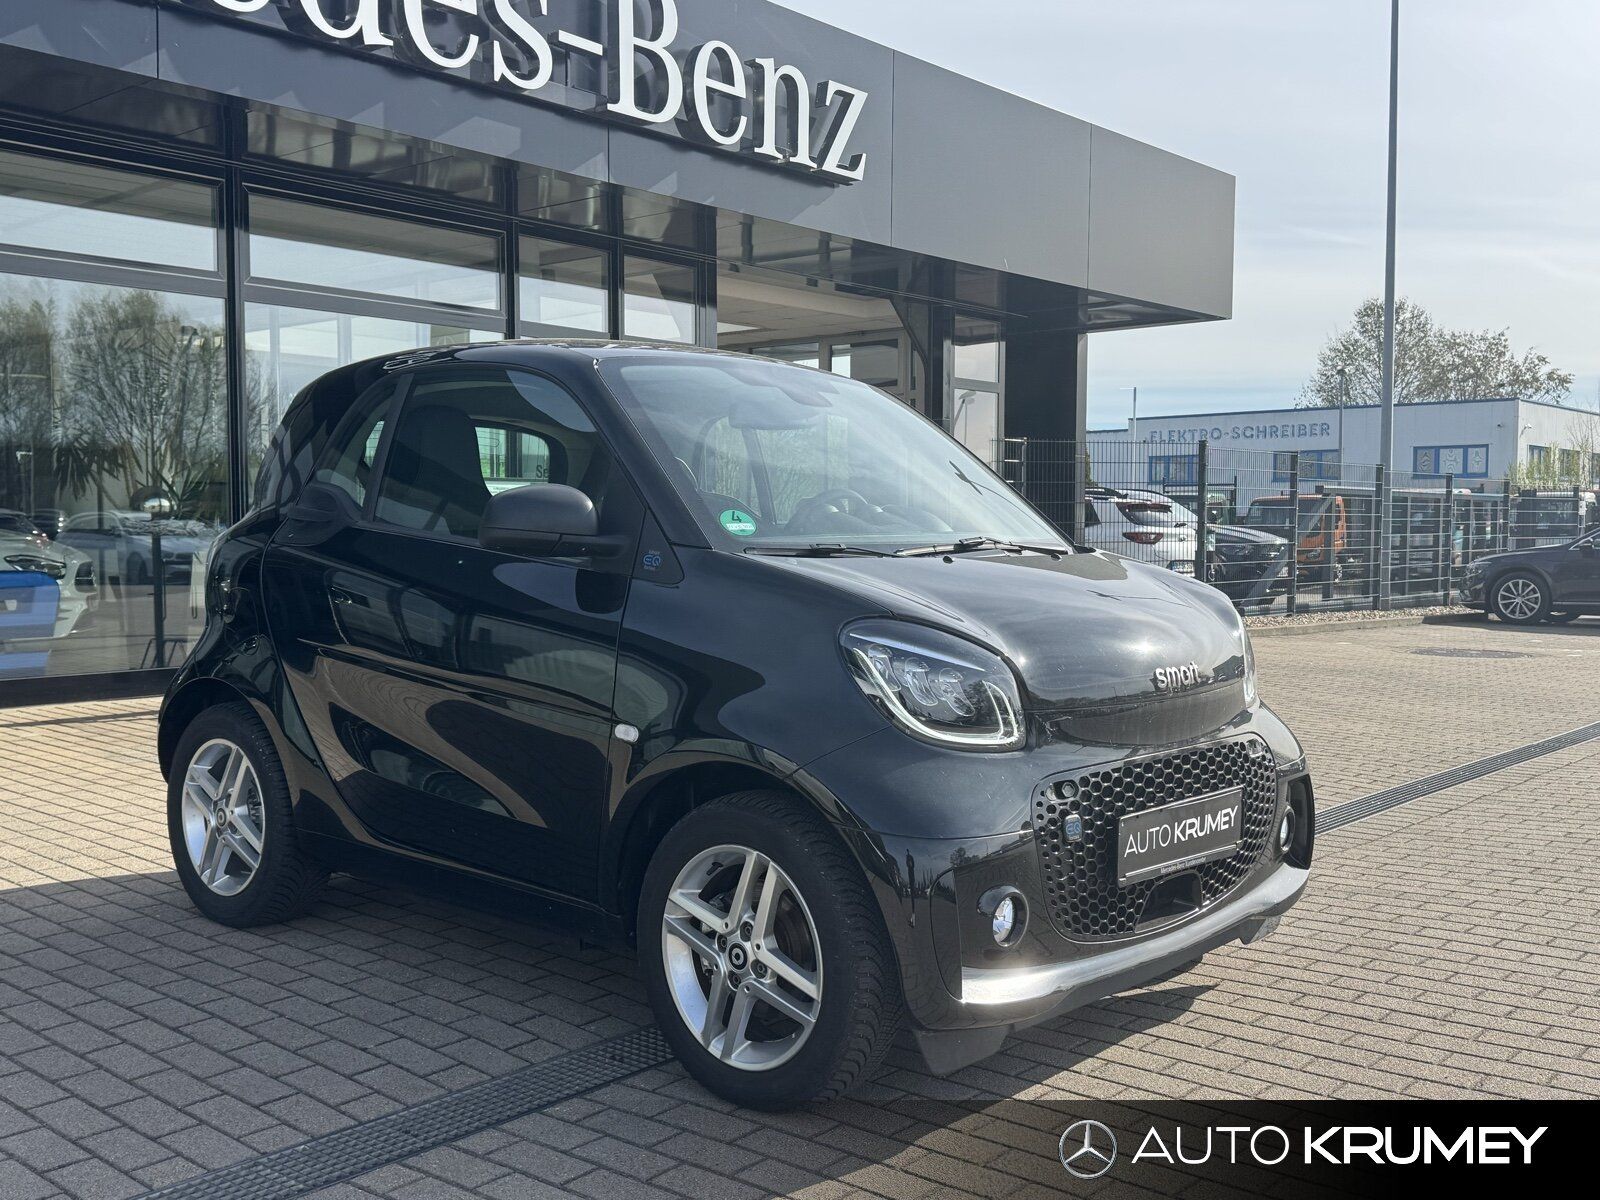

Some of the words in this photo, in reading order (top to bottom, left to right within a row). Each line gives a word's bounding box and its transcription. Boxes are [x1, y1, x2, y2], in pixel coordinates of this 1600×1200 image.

[1149, 422, 1330, 443] ELEKTRO-SCHREIBER
[1155, 661, 1201, 689] smart
[1124, 824, 1171, 858] AUTO
[1174, 805, 1239, 844] KRUMEY
